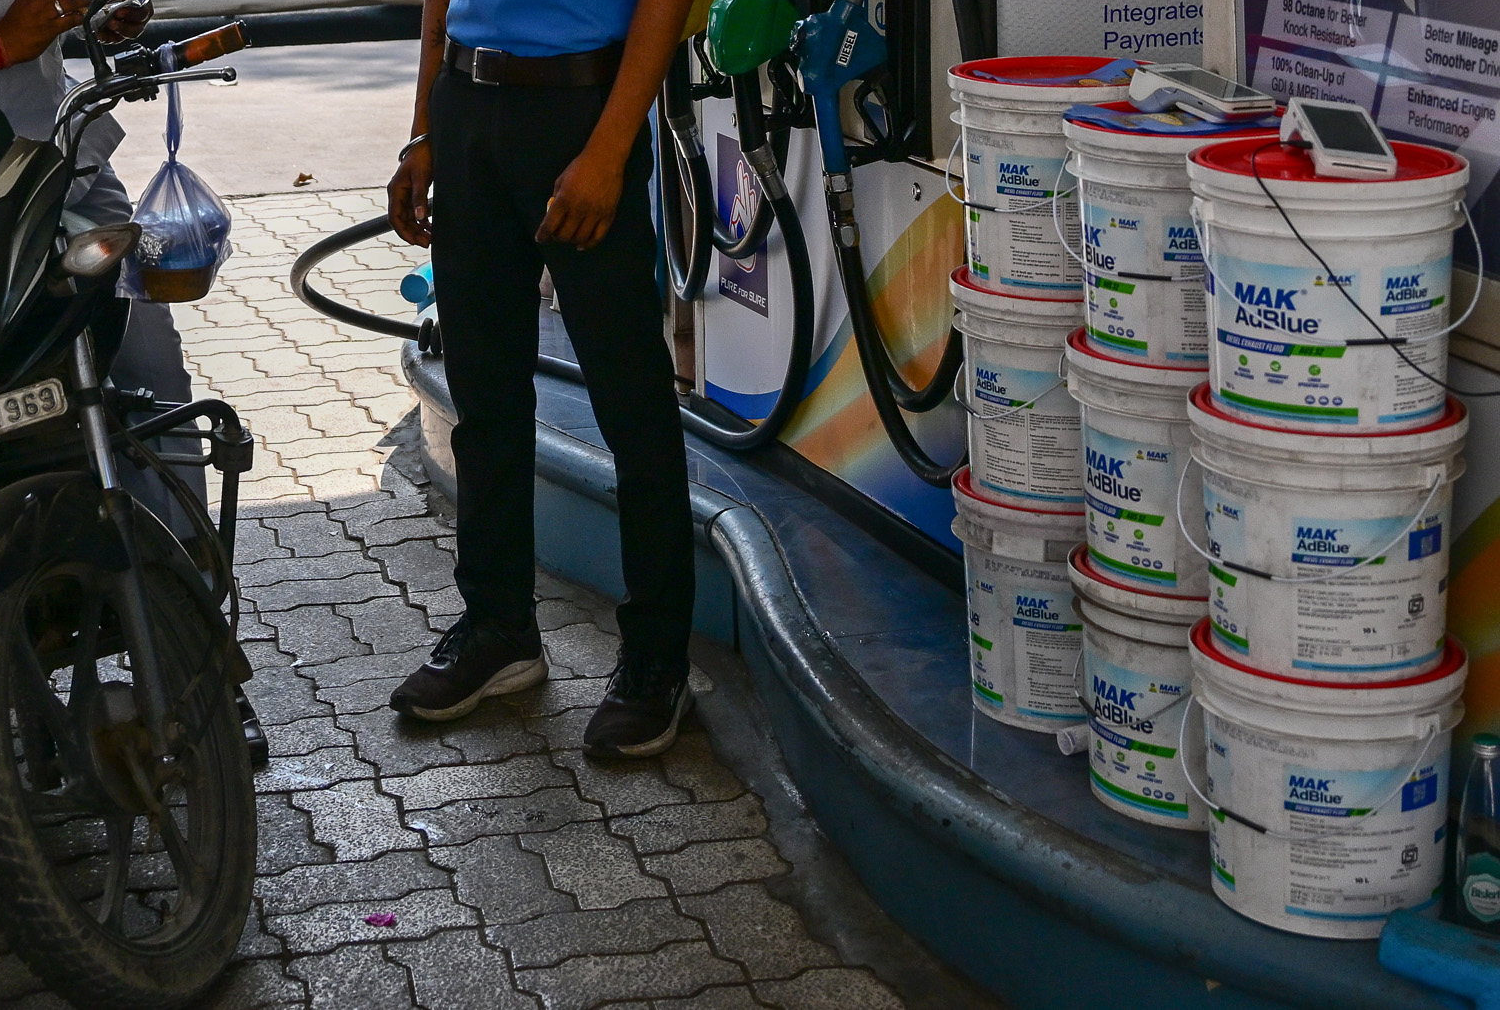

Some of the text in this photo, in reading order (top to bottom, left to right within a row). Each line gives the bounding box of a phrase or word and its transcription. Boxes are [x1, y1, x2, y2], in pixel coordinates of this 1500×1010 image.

[1295, 1, 1326, 19] Octane
[1327, 6, 1339, 21] for
[1341, 8, 1367, 27] Better
[1283, 19, 1356, 48] Knock Resistance
[1424, 24, 1499, 55] Better Mileage
[838, 32, 857, 65] DIESEL
[1425, 48, 1476, 72] Smoother
[1271, 55, 1346, 86] 100% Clean-Up of
[1271, 77, 1287, 92] GDI
[1288, 82, 1295, 94] &
[1408, 87, 1496, 121] Enhanced Engine
[1408, 110, 1470, 138] Performance
[1000, 163, 1031, 175] MAK
[1000, 173, 1039, 186] AdBlue
[1118, 218, 1138, 227] MAK
[1085, 246, 1115, 271] Blue
[1386, 275, 1421, 290] MAK
[1234, 281, 1299, 312] MAK
[1386, 287, 1427, 303] AdBlue
[1234, 305, 1319, 334] AdBlue
[1241, 336, 1265, 351] EXHAUST
[1266, 341, 1285, 353] FLUID
[977, 368, 999, 383] MAK
[977, 381, 1007, 395] AdBlue
[1086, 446, 1125, 479] MAK
[1147, 451, 1169, 459] MAK
[1087, 468, 1142, 502] AdBlue
[1222, 505, 1240, 516] MAK
[1297, 527, 1338, 541] MAK
[1297, 539, 1349, 554] AdBlue
[981, 582, 995, 591] MAK
[1016, 595, 1050, 609] MAK
[1017, 608, 1059, 620] AdBlue
[1093, 675, 1137, 711] MAK
[1159, 684, 1182, 693] MAK
[1094, 696, 1154, 734] AdBlue
[1289, 775, 1332, 791] MAK
[1289, 788, 1342, 804] AdBlue
